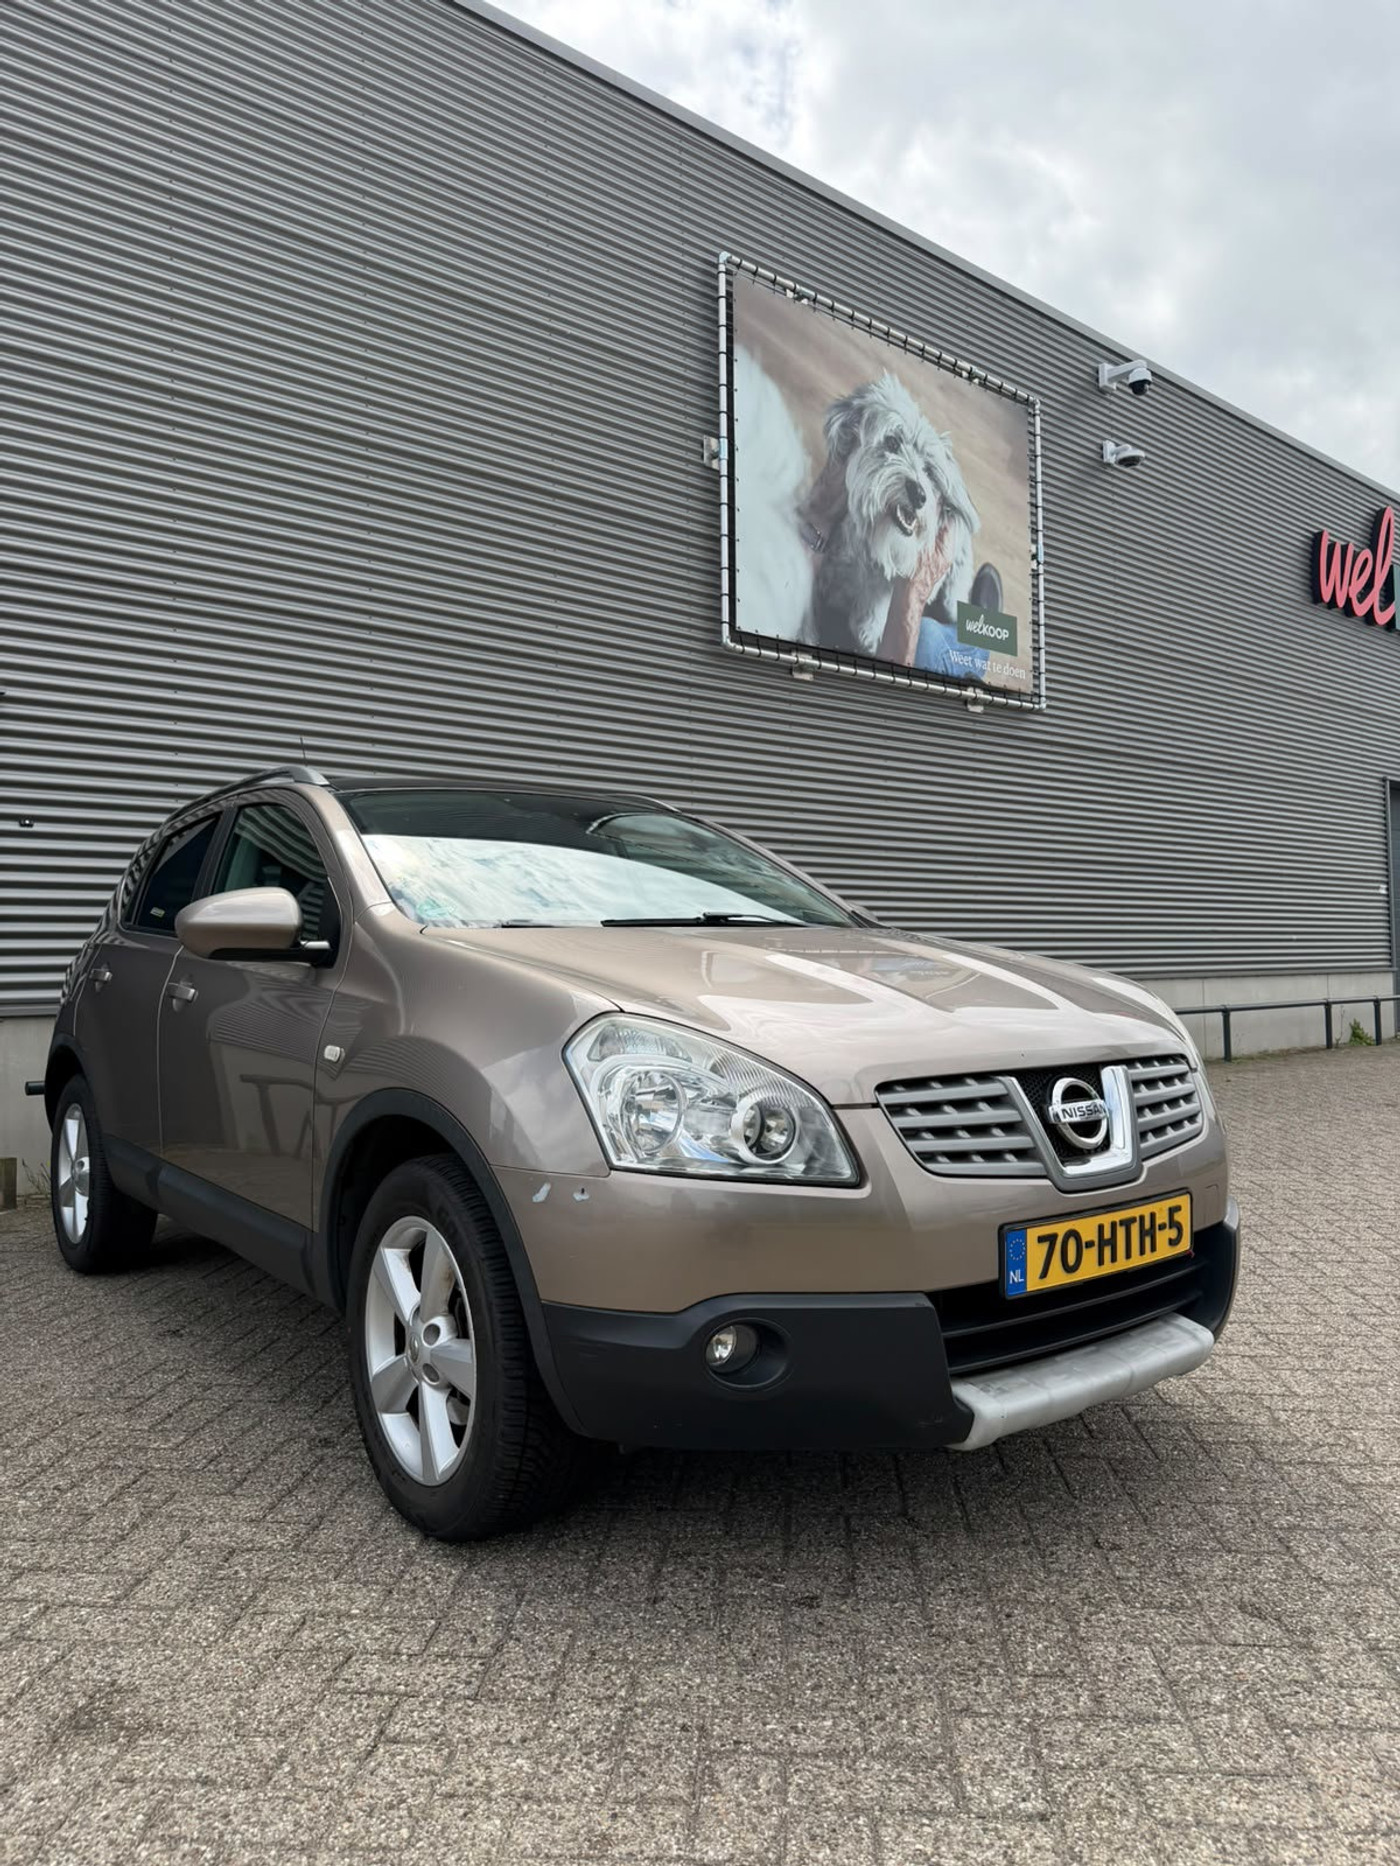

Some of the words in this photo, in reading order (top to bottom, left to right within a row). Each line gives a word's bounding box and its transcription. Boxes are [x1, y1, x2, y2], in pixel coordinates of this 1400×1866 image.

[1317, 505, 1400, 630] wel
[949, 649, 973, 668] Weet
[975, 658, 991, 672] wat
[992, 661, 1003, 674] te
[1003, 662, 1026, 680] doen
[1061, 1101, 1107, 1119] NISSAN
[1036, 1204, 1184, 1281] 70-HTH-5
[1008, 1269, 1025, 1285] NL
